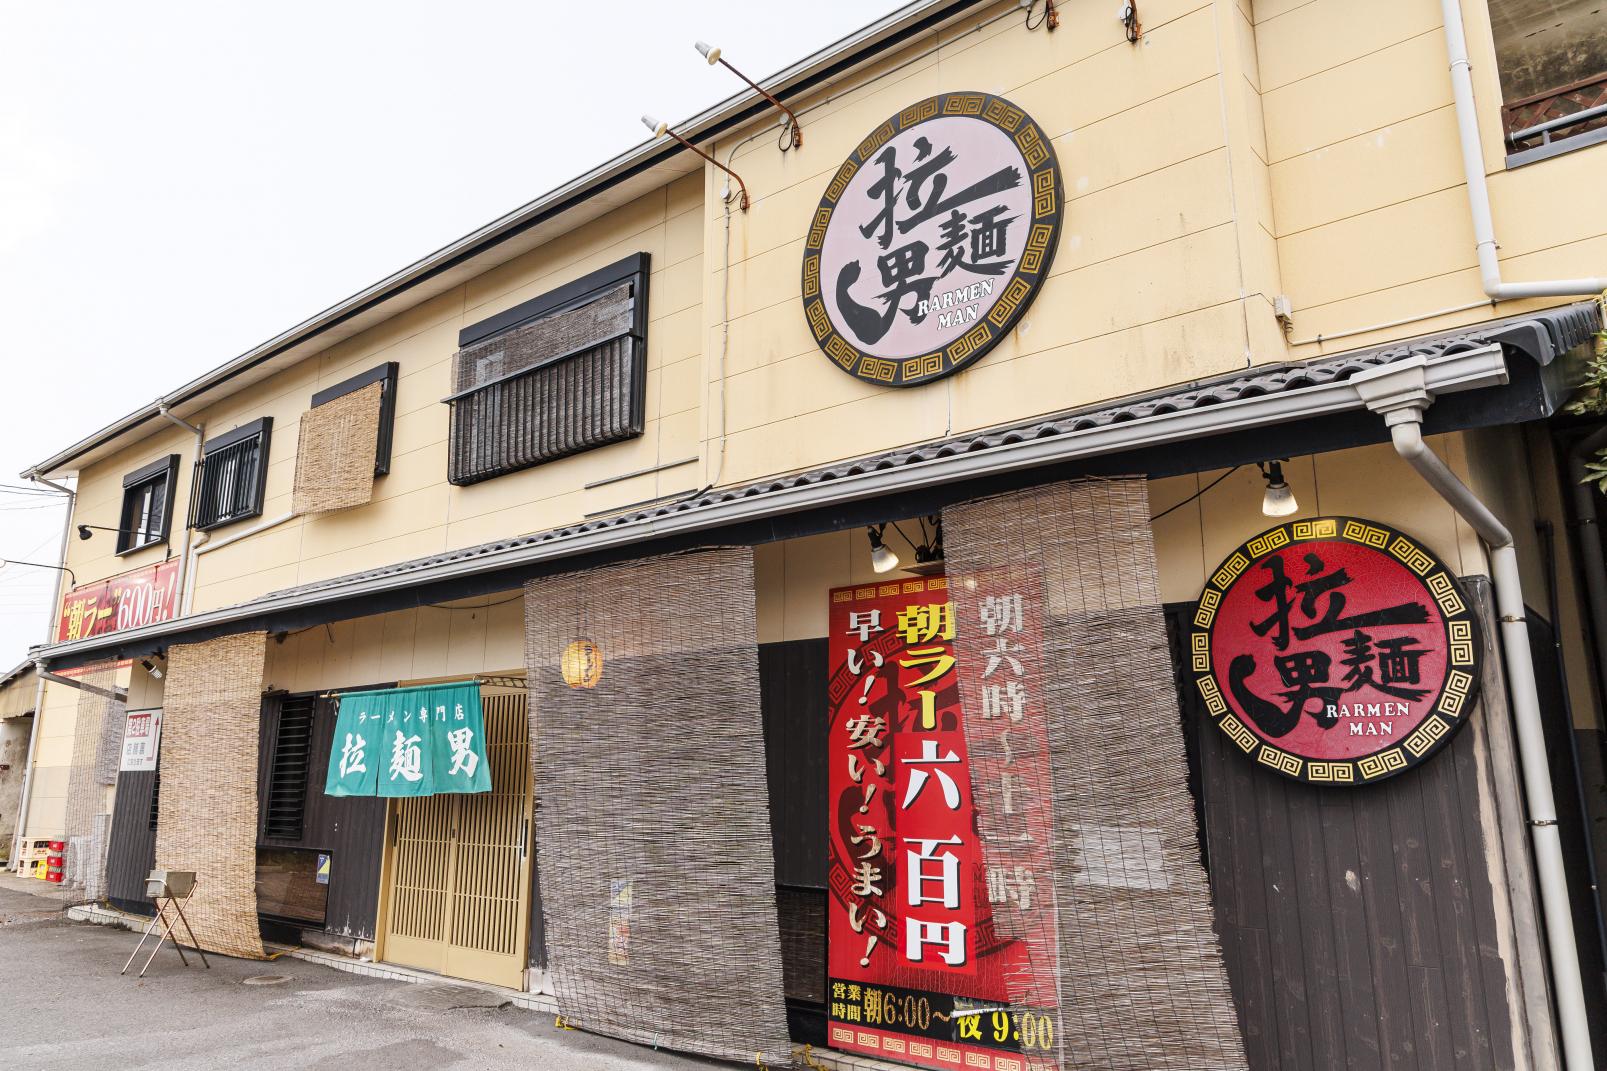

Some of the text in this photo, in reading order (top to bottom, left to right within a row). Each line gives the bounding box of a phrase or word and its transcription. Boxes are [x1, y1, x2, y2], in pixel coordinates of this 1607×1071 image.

[917, 278, 995, 316] RARMEN
[937, 304, 979, 330] MAN
[358, 703, 465, 725] ラーメン専門店
[1326, 702, 1410, 718] RARMEN
[1349, 721, 1393, 736] MAN
